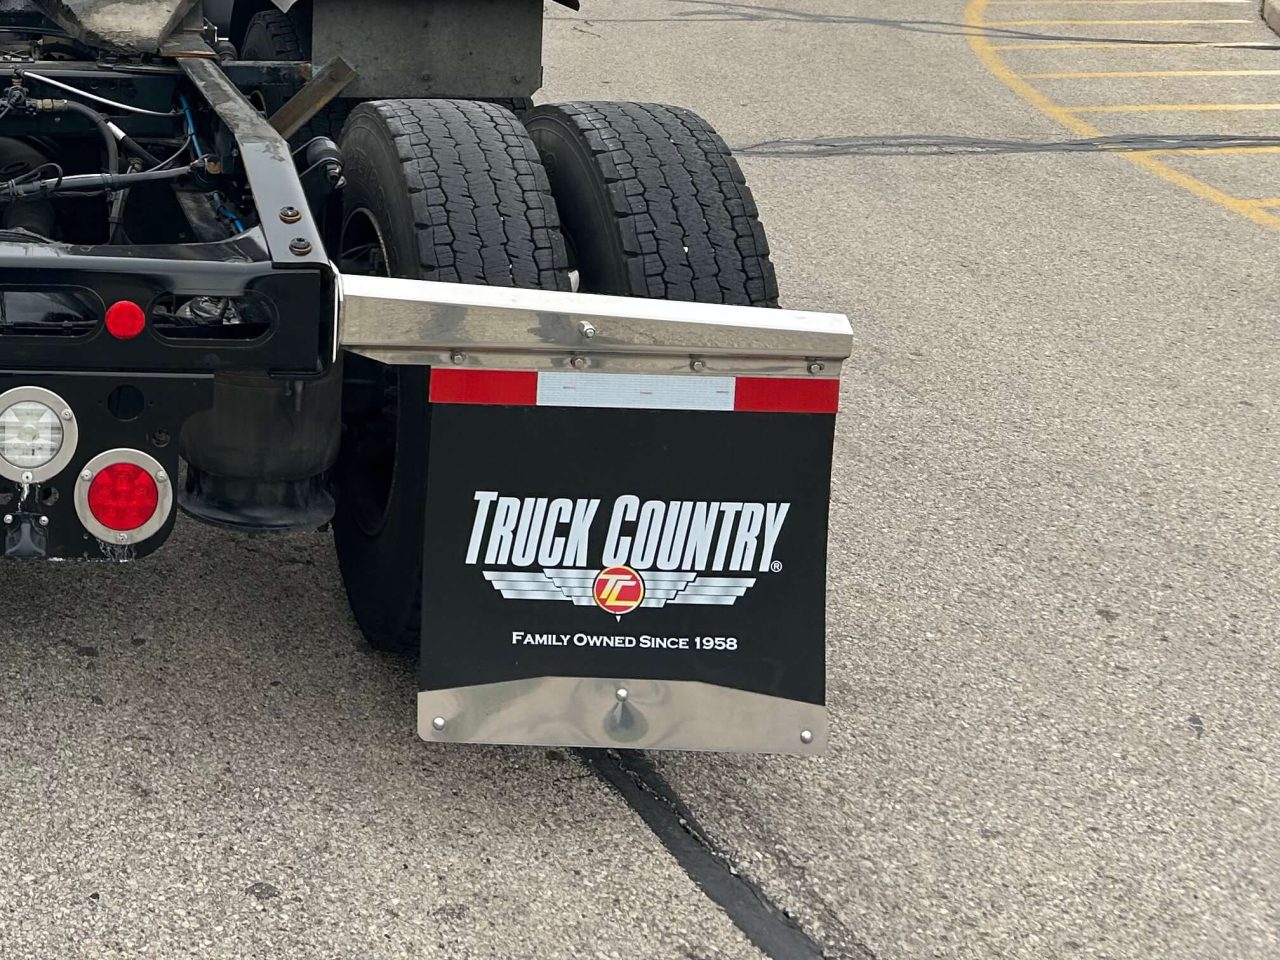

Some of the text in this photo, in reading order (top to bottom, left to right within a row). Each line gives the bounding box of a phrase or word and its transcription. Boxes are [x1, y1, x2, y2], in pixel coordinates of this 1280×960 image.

[465, 490, 600, 567] TRUCK
[512, 631, 738, 651] FAMILY OWNED SINCE 1958
